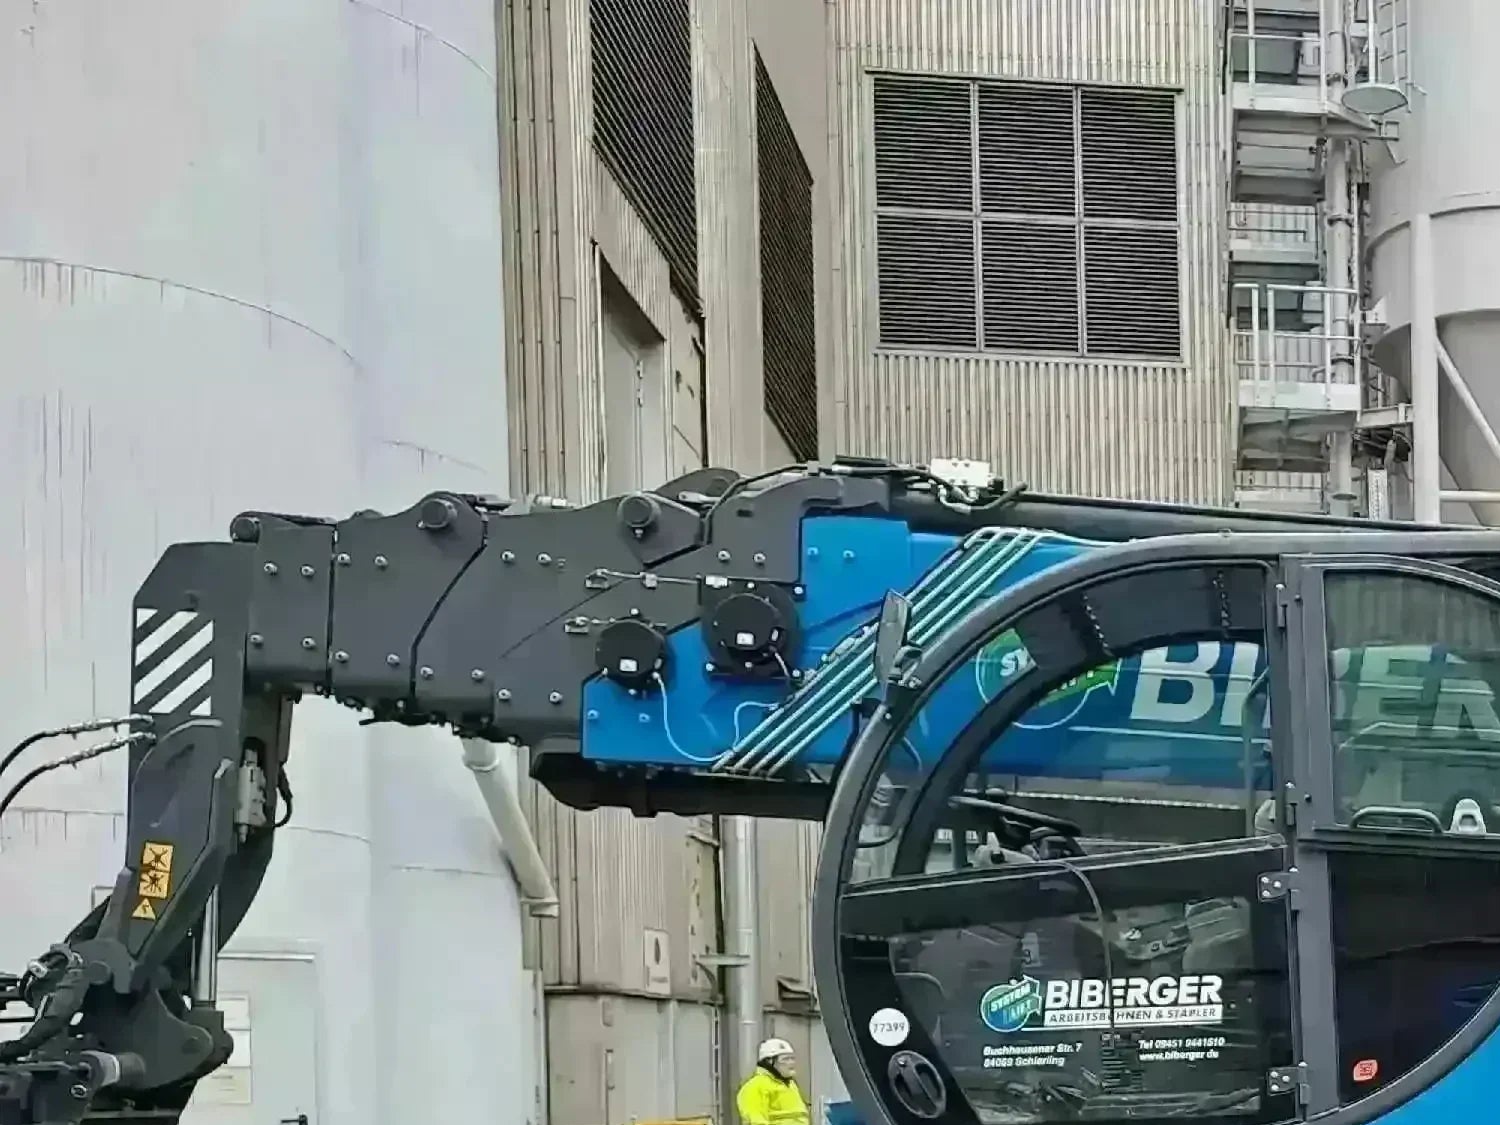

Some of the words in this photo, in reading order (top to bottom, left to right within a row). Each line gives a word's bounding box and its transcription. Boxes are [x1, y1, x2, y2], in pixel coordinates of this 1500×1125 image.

[1045, 975, 1223, 1008] BIBERGER
[1050, 1009, 1152, 1022] ARBEITSBHNEN
[1138, 1040, 1153, 1050] Tel
